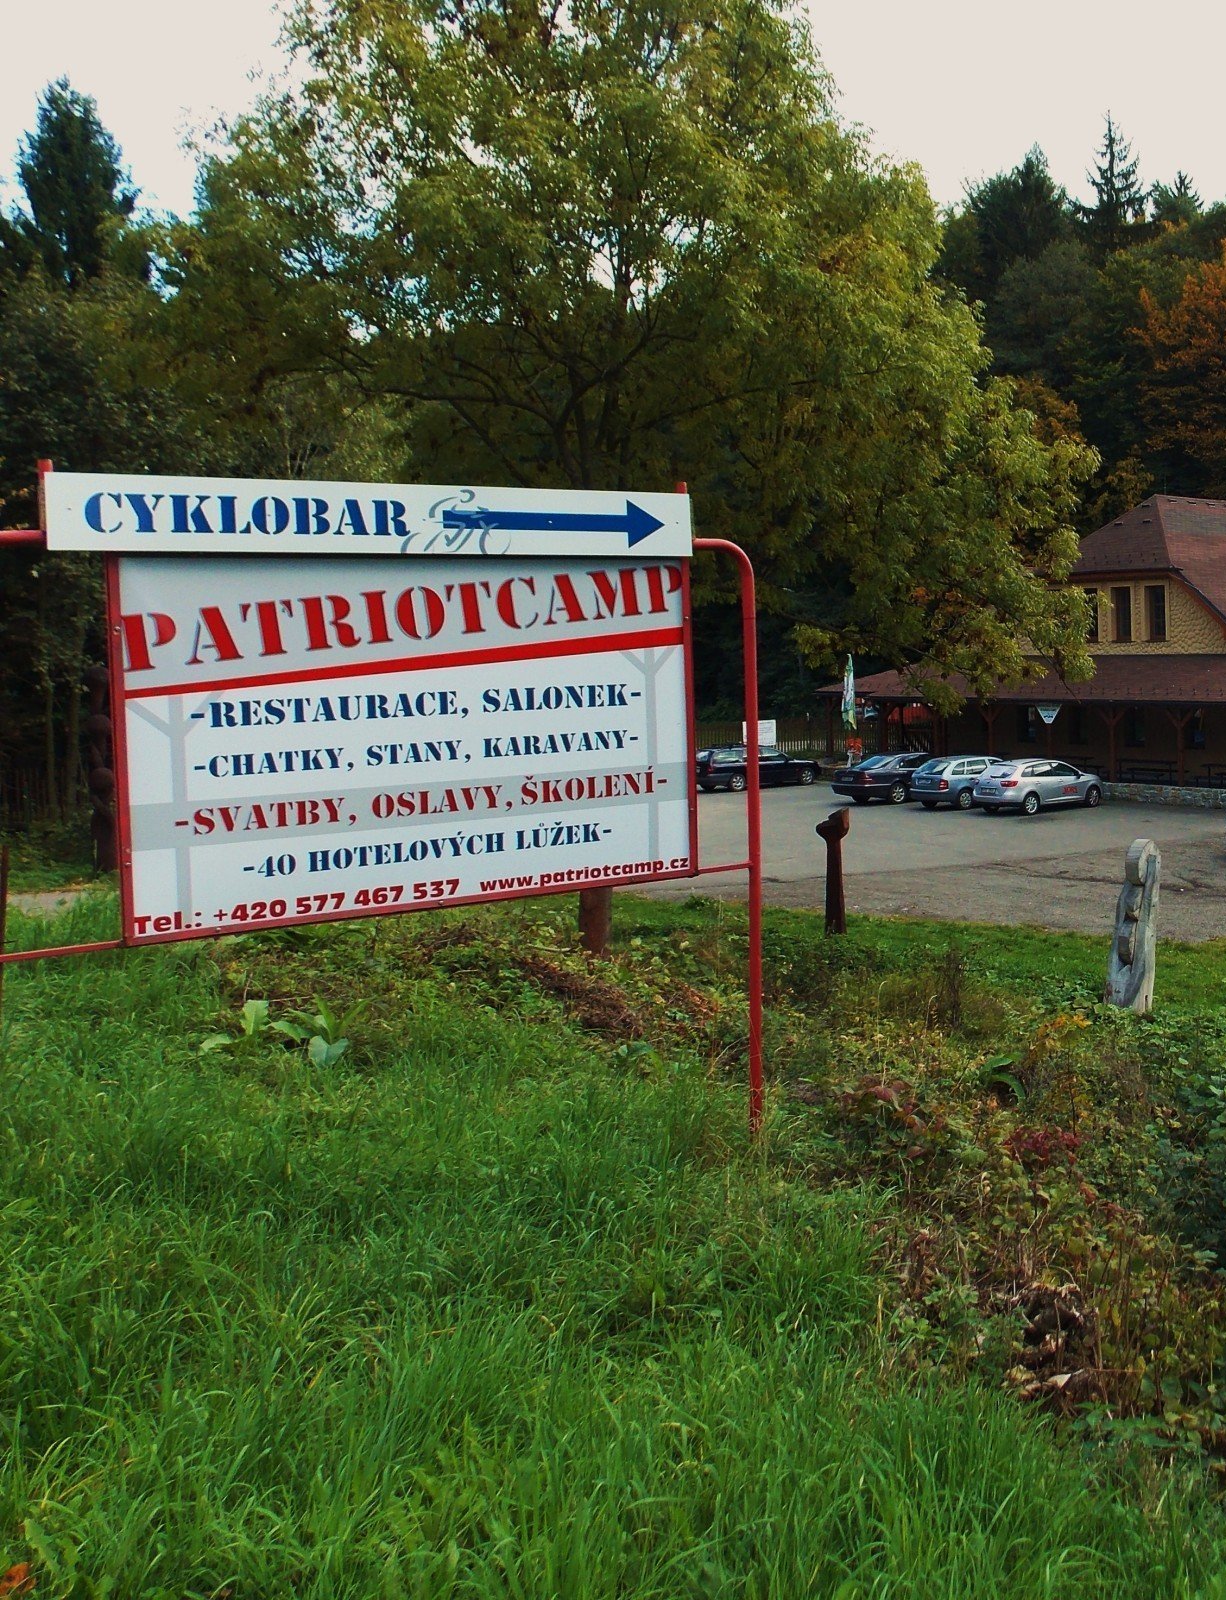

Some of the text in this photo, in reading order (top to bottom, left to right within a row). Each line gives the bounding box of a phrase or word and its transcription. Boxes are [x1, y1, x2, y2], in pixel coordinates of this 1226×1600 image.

[84, 492, 411, 537] CYKLOBAR
[121, 565, 683, 672] PATRIOTCAMP
[190, 683, 642, 728] -RESTAURACE, SALONEK-
[194, 729, 639, 778] -CHATKY, STANY, KARAVANY-
[175, 766, 668, 836] -SVATBY, OSLAVY, ŠKOLENÍ-
[243, 821, 613, 878] -40 HOTELOVÝCH LŮŽEK-
[134, 857, 690, 935] Tel.: +420 577 467 537 www.patriotcamp.cz
